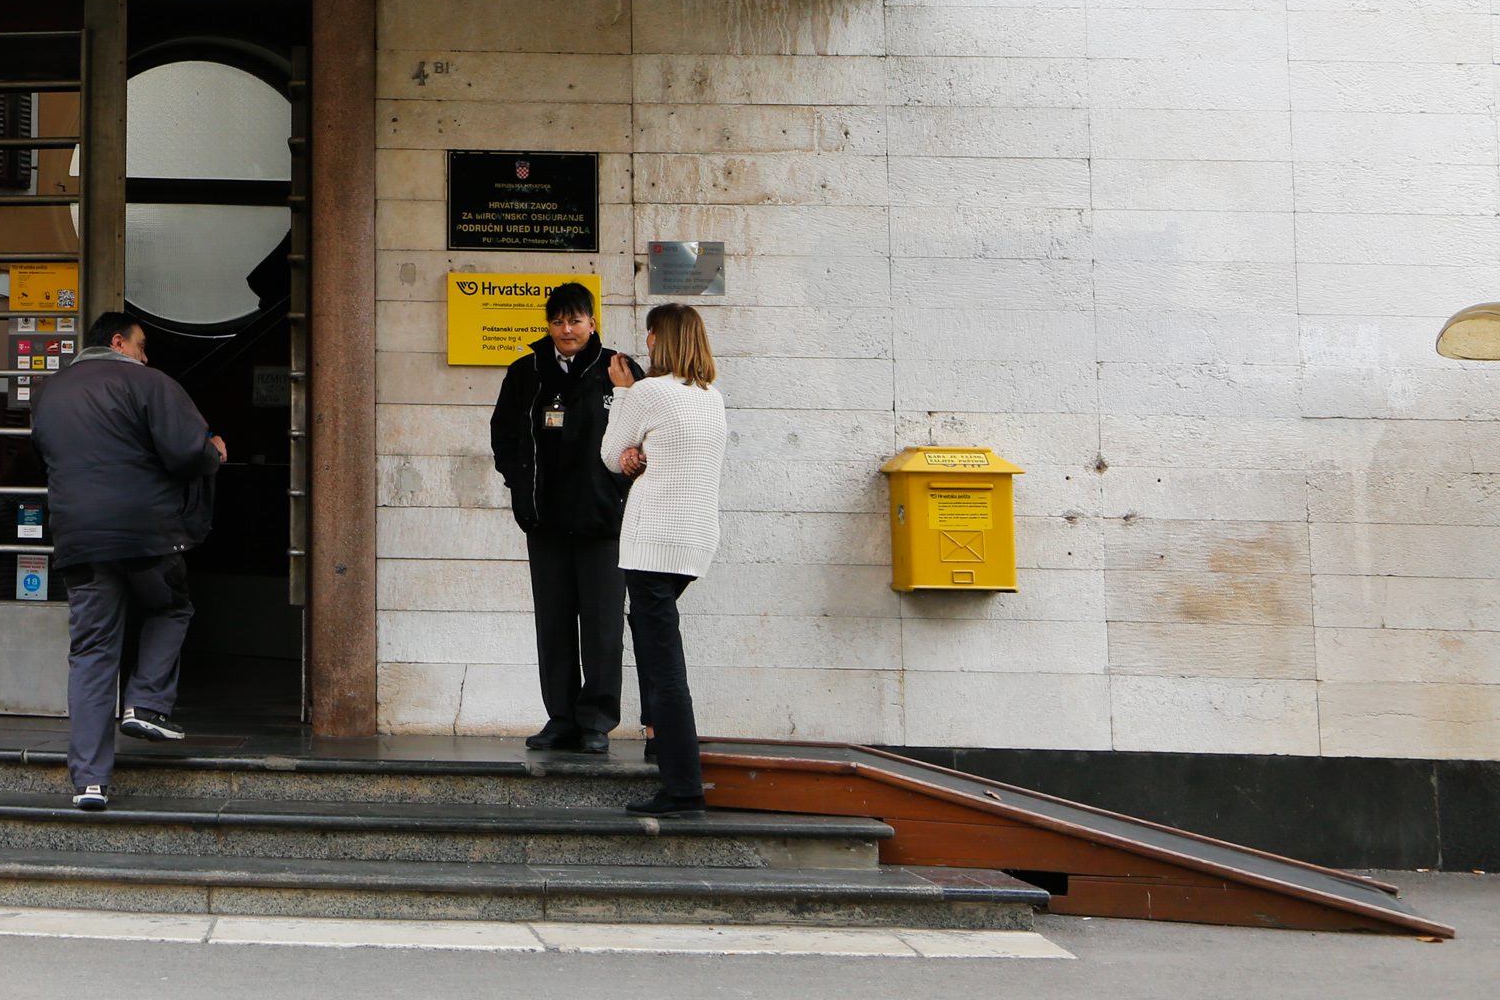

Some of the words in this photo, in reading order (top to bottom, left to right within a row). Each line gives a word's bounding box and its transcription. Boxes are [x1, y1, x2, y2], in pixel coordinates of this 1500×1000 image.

[411, 61, 429, 86] 4
[488, 201, 528, 210] HRVATSKI
[530, 202, 558, 210] ZAVOD
[462, 212, 473, 220] ZA
[530, 214, 585, 222] OSIGURANJE
[456, 222, 503, 232] PODRUČNI
[506, 225, 531, 233] URED
[533, 225, 540, 233] U
[543, 226, 591, 234] PULI-POLA
[482, 281, 541, 296] Hrvatska
